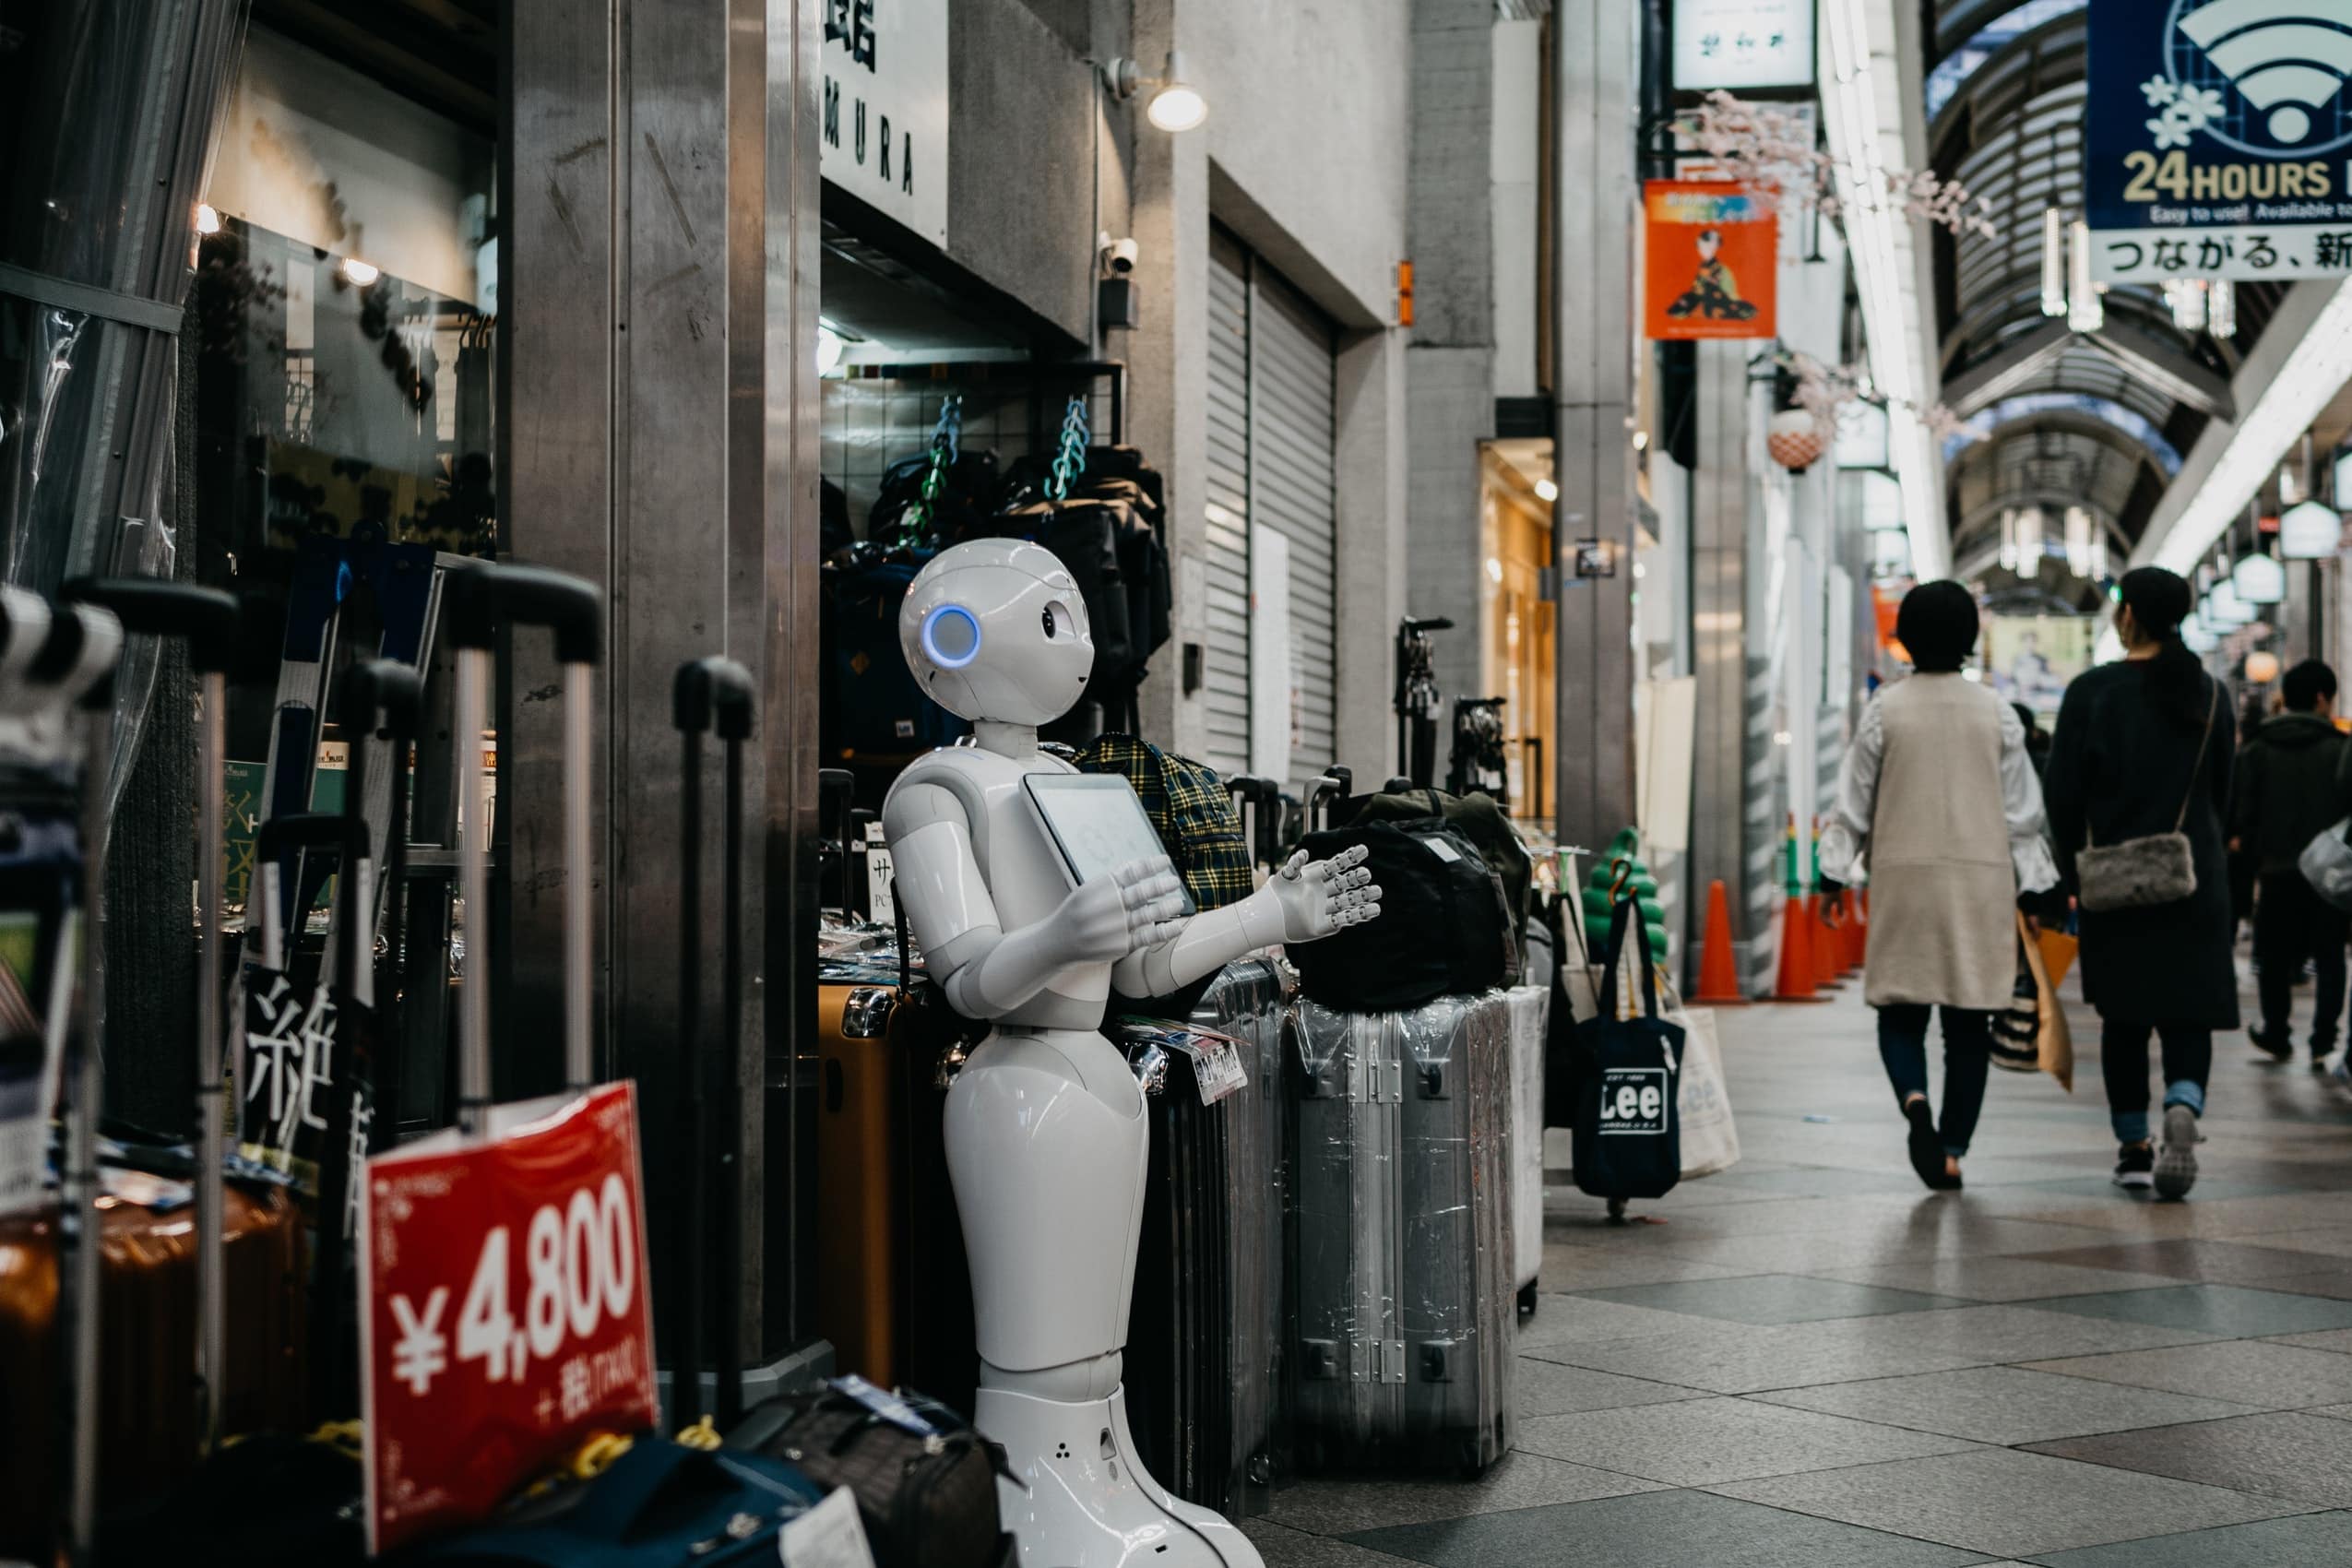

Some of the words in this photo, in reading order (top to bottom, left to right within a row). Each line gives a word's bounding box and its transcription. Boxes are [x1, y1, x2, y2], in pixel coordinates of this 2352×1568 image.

[2123, 150, 2332, 201] 24HOURS
[2150, 206, 2189, 225] Easy
[2192, 207, 2210, 221] to
[2255, 202, 2334, 220] Available
[1600, 1085, 1660, 1119] Lee
[389, 1172, 634, 1396] ¥4,800
